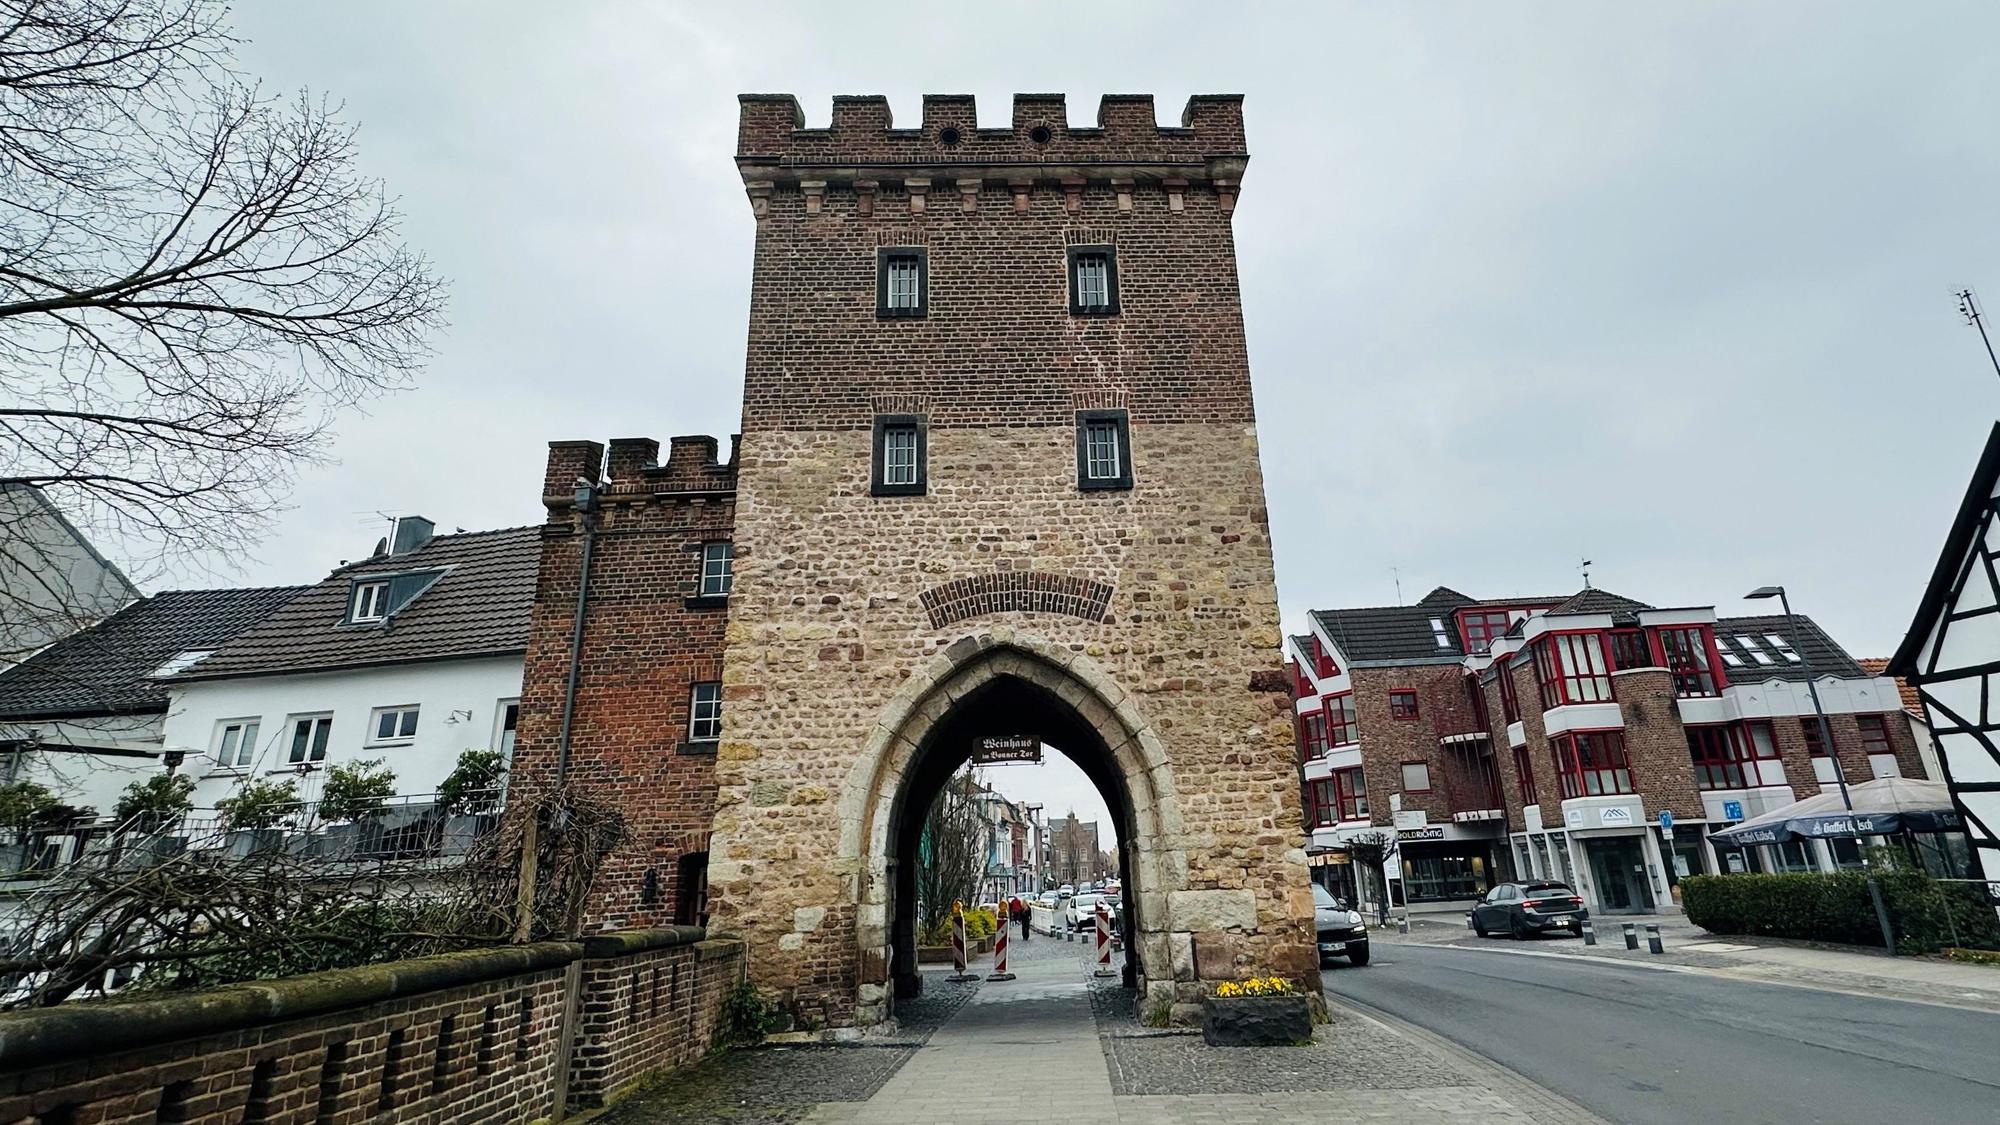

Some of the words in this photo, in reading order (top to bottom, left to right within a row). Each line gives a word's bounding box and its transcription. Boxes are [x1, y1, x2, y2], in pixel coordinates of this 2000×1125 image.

[983, 738, 1032, 749] Weinhaus
[990, 750, 1018, 759] Bonner
[1019, 750, 1033, 758] Tor
[1823, 820, 1848, 834] Gaffel
[1847, 818, 1874, 833] Klsch
[1736, 831, 1756, 844] Gaffel
